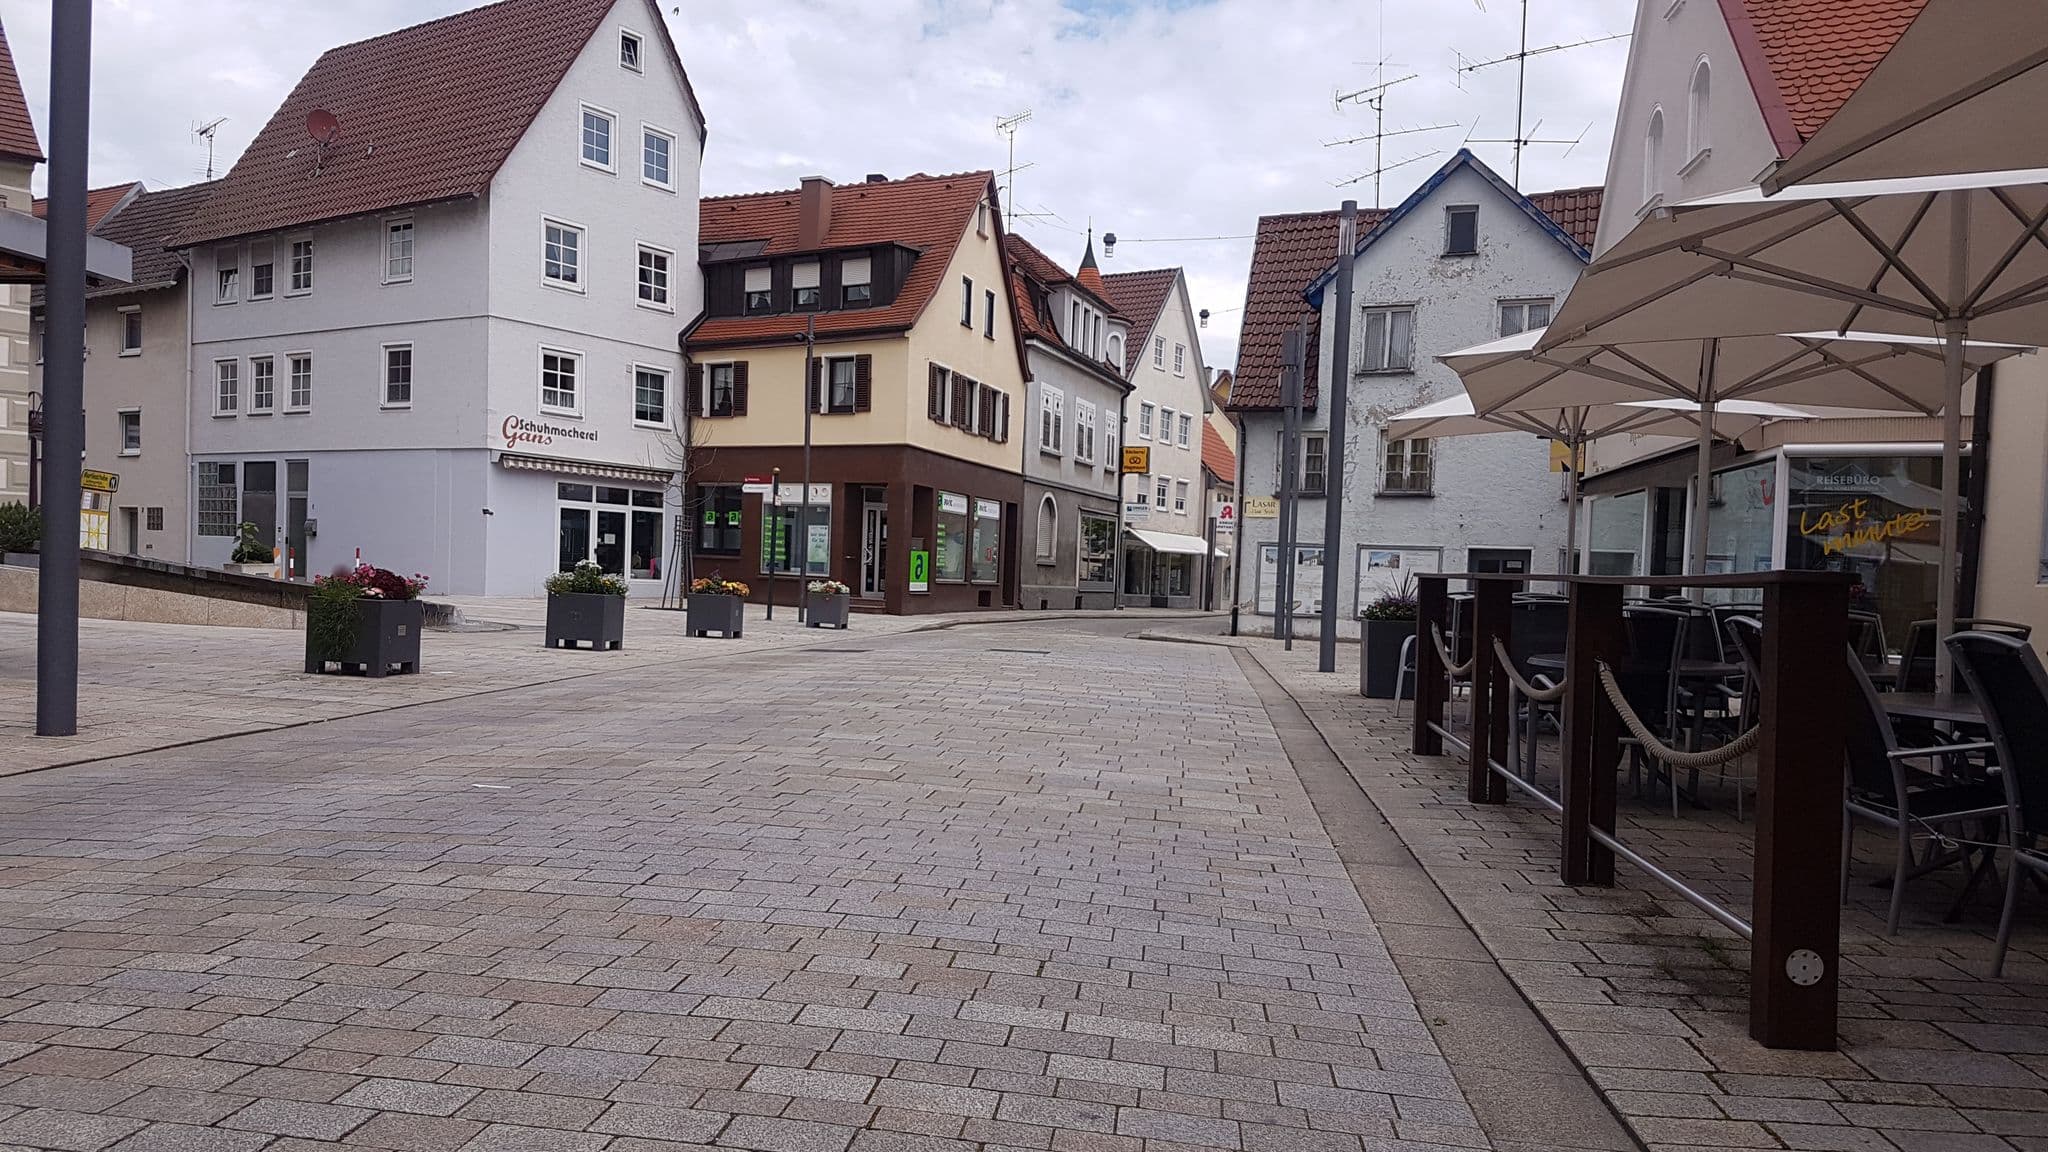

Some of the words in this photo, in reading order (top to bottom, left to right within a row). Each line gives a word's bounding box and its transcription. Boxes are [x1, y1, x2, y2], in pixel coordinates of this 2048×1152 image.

[502, 415, 552, 448] Gans
[519, 419, 598, 441] Schuhmacherei
[1816, 474, 1880, 485] REISEBÜRO
[1801, 499, 1868, 535] Last
[1823, 507, 1929, 555] minute!
